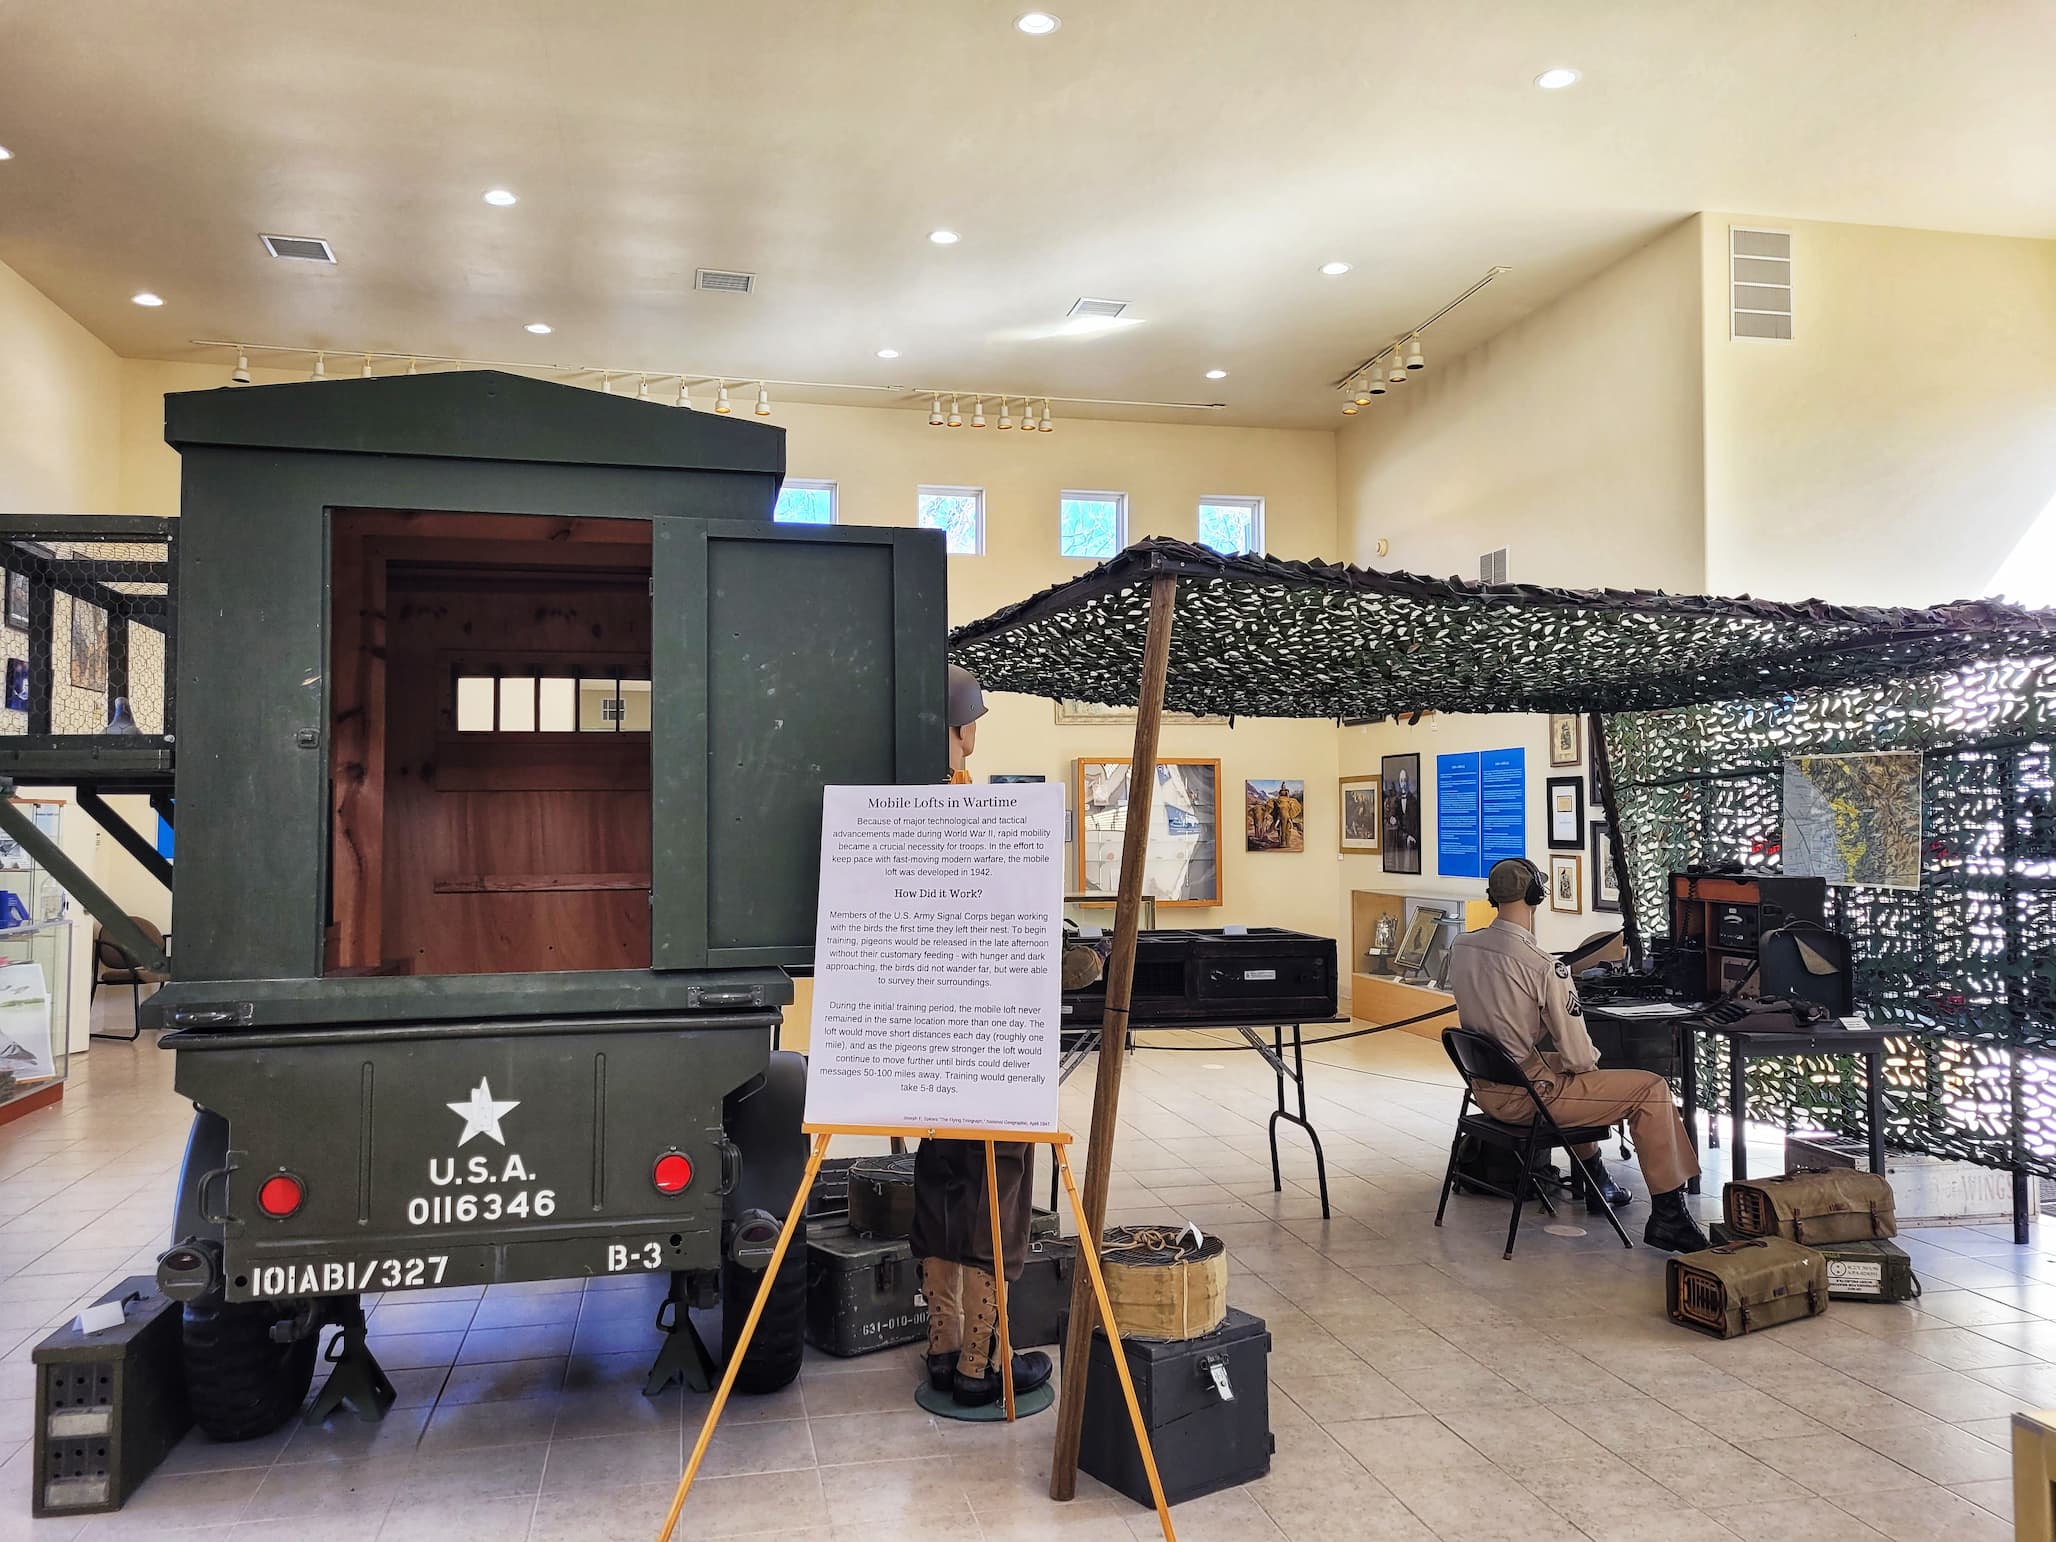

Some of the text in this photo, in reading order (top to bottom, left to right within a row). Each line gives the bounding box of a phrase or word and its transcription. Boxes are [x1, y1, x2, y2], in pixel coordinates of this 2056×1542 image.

[868, 796, 1017, 808] Mobile Lofts in Wartime
[857, 815, 1027, 827] Because major technological and tactical
[832, 828, 1050, 839] advancements made during World War rapid mobility
[838, 842, 870, 850] became
[879, 842, 906, 850] crucial
[907, 842, 944, 852] necessity
[946, 842, 957, 850] for
[989, 842, 996, 850] In
[998, 841, 1011, 850] the
[1013, 841, 1034, 849] effort
[832, 855, 852, 864] keep
[853, 856, 872, 864] pace
[875, 854, 891, 863] with
[893, 855, 939, 865] fast-moving
[941, 855, 972, 863] modern
[1022, 854, 1049, 863] mobile
[884, 867, 897, 875] loft
[917, 867, 958, 878] developed
[895, 888, 982, 898] How Did it Work?
[829, 911, 867, 919] Members
[878, 911, 892, 919] the
[913, 912, 934, 921] Army
[936, 911, 962, 921] Signal
[964, 912, 988, 922] Corps
[990, 912, 1016, 922] began
[1017, 911, 1048, 922] working
[830, 923, 846, 931] with
[848, 923, 861, 932] the
[863, 923, 883, 932] birds
[885, 924, 898, 932] the
[900, 924, 914, 932] first
[916, 924, 934, 932] time
[936, 925, 954, 935] they
[955, 924, 968, 933] left
[970, 925, 988, 933] their
[1010, 925, 1022, 934] To
[1024, 925, 1046, 935] begin
[860, 936, 892, 946] pigeons
[894, 937, 918, 945] would
[920, 937, 930, 946] be
[933, 938, 968, 946] released
[979, 938, 992, 946] the
[994, 938, 1009, 947] late
[1011, 938, 1048, 947] afternoon
[829, 949, 1045, 962] without their customary feeding with hunger and dark
[879, 963, 892, 971] the
[894, 963, 914, 971] birds
[916, 963, 929, 972] did
[931, 964, 944, 972] not
[946, 964, 976, 972] wander
[994, 965, 1006, 973] but
[1030, 965, 1048, 974] able
[888, 978, 914, 986] survey
[916, 976, 934, 985] their
[829, 1001, 856, 1011] During
[858, 1001, 871, 1009] the
[873, 1002, 894, 1010] initial
[896, 1002, 926, 1013] training
[959, 1004, 972, 1012] the
[974, 1004, 1001, 1013] mobile
[1003, 1005, 1016, 1014] loft
[824, 1014, 862, 1022] remained
[874, 1015, 887, 1023] the
[913, 1016, 946, 1025] location
[971, 1018, 989, 1026] than
[1030, 1019, 1044, 1028] The
[824, 1026, 836, 1035] loft
[838, 1027, 862, 1036] would
[889, 1029, 910, 1037] short
[912, 1029, 951, 1038] distances
[953, 1031, 973, 1039] each
[975, 1031, 990, 1041] day
[1028, 1034, 1044, 1042] one
[849, 1041, 865, 1049] and
[879, 1042, 892, 1050] the
[894, 1042, 926, 1053] pigeons
[928, 1045, 949, 1054] grew
[951, 1045, 985, 1055] stronger
[987, 1045, 1000, 1054] the
[1002, 1045, 1016, 1054] loft
[1017, 1046, 1042, 1055] would
[835, 1054, 870, 1063] continue
[907, 1056, 934, 1065] further
[936, 1057, 954, 1066] until
[955, 1057, 976, 1066] birds
[977, 1058, 1000, 1067] could
[1002, 1059, 1030, 1068] deliver
[819, 1068, 861, 1077] messages
[863, 1068, 892, 1077] 50-100
[894, 1069, 916, 1078] miles
[946, 1071, 978, 1082] Training
[980, 1072, 1005, 1081] would
[1007, 1073, 1045, 1084] generally
[900, 1083, 918, 1091] take
[920, 1083, 934, 1092] 5-8
[429, 1154, 536, 1186] U.S.A.
[608, 1242, 662, 1272] B-3
